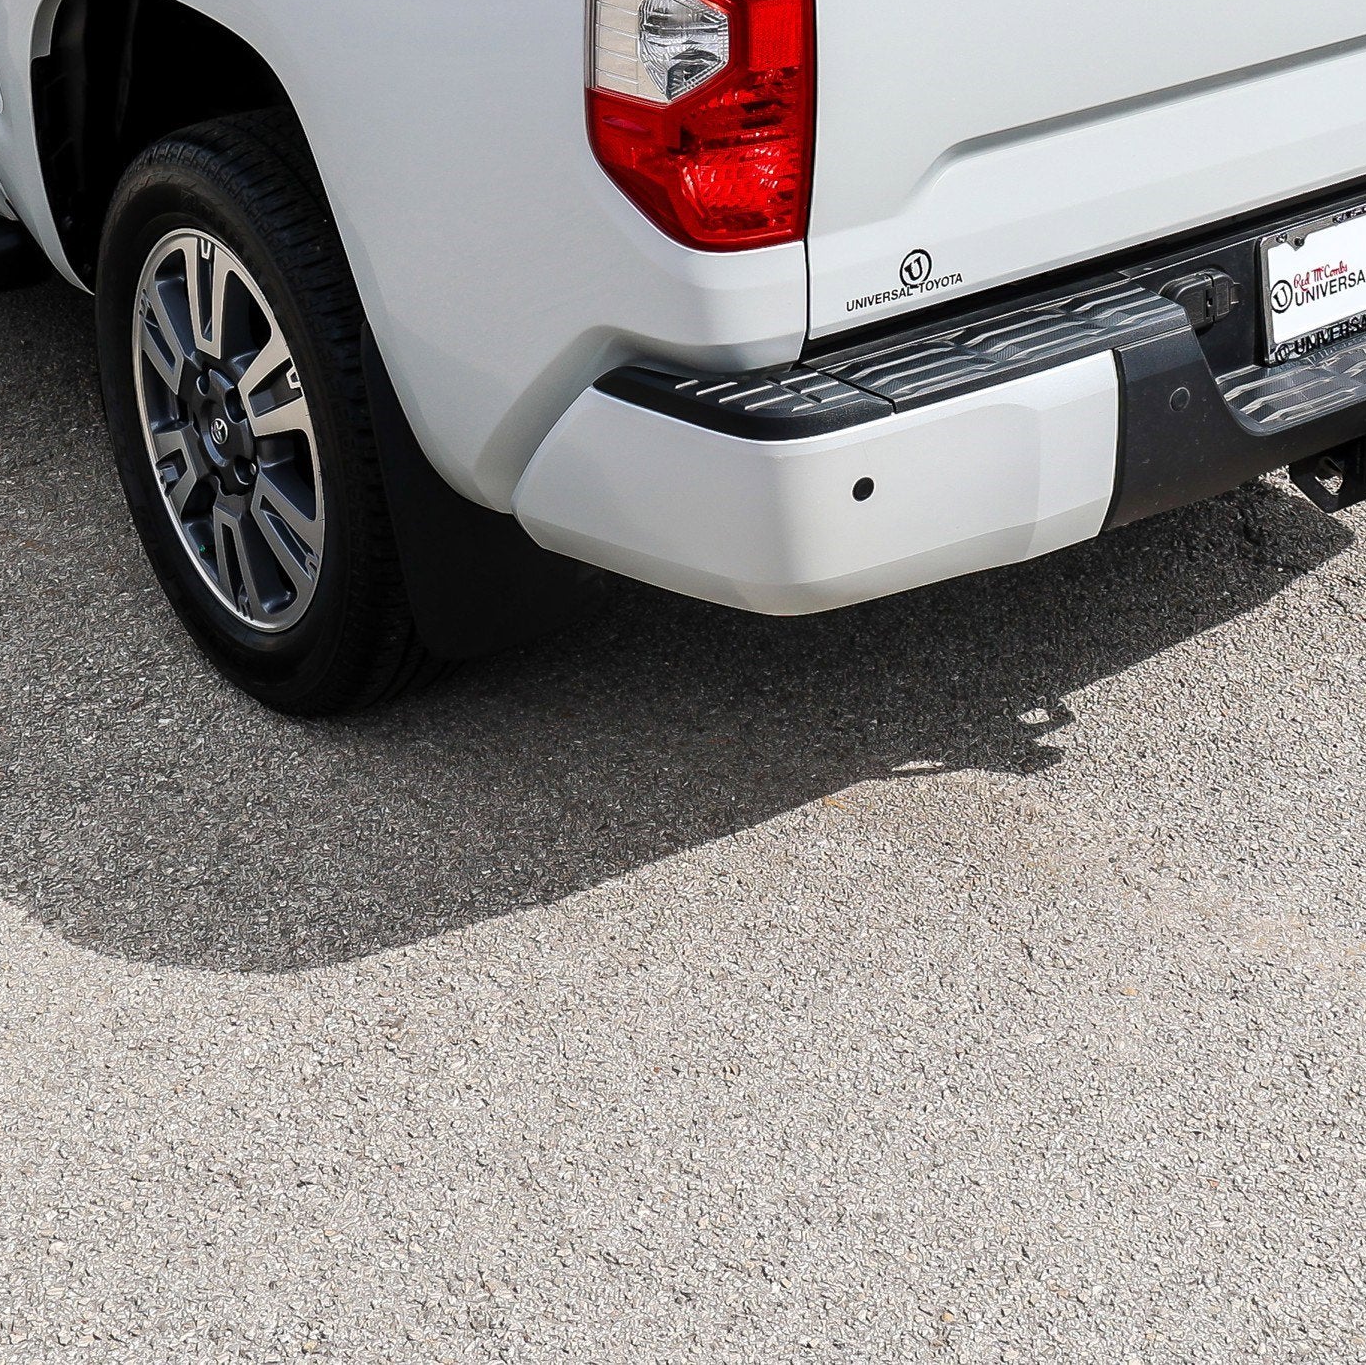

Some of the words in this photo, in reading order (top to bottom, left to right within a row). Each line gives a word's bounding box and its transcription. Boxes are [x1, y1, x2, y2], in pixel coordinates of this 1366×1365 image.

[846, 287, 913, 311] UNIVERSAL
[918, 273, 963, 293] TOYOTA
[1294, 273, 1310, 291] Red
